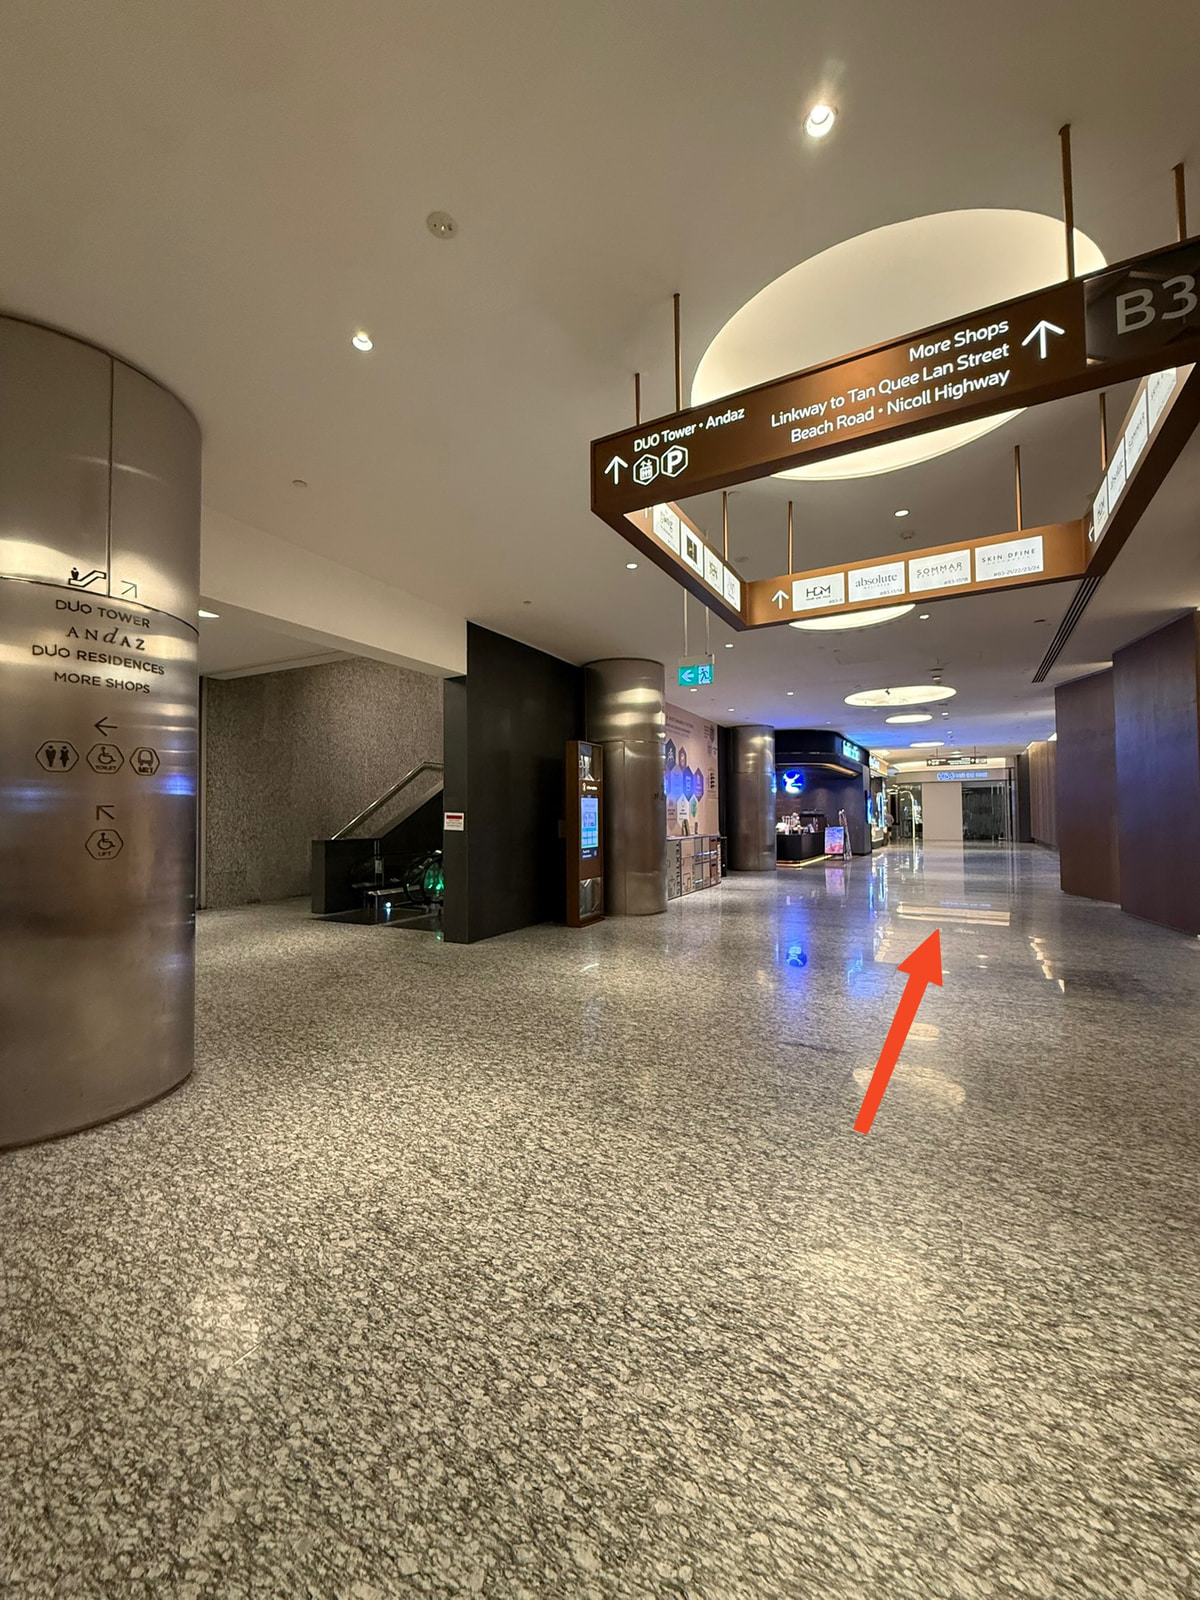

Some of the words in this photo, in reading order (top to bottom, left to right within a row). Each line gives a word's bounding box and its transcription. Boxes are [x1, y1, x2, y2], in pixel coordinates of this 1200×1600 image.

[1116, 274, 1198, 335] B3
[908, 339, 951, 362] More
[953, 320, 1010, 348] Shops
[771, 400, 828, 428] Linkway
[830, 396, 846, 410] to
[847, 386, 876, 403] Tan
[878, 372, 920, 395] Quee
[922, 361, 954, 382] Lan
[956, 343, 1010, 371] Street
[790, 419, 834, 444] Beach
[836, 405, 875, 430] Road
[886, 388, 932, 416] Nicoll
[934, 369, 1011, 402] Highway
[633, 433, 660, 453] DUO
[660, 423, 697, 444] Tower
[705, 408, 746, 430] Andaz
[916, 561, 962, 576] SOMMAR
[981, 554, 1003, 564] SKIN
[1007, 547, 1036, 560] DFINE
[855, 574, 898, 588] absolute
[55, 599, 93, 615] DUO
[97, 606, 151, 629] TOWER
[31, 644, 71, 658] DUO
[76, 649, 165, 675] RESIDENCES
[54, 671, 101, 687] MORE
[105, 677, 151, 694] SHOPS
